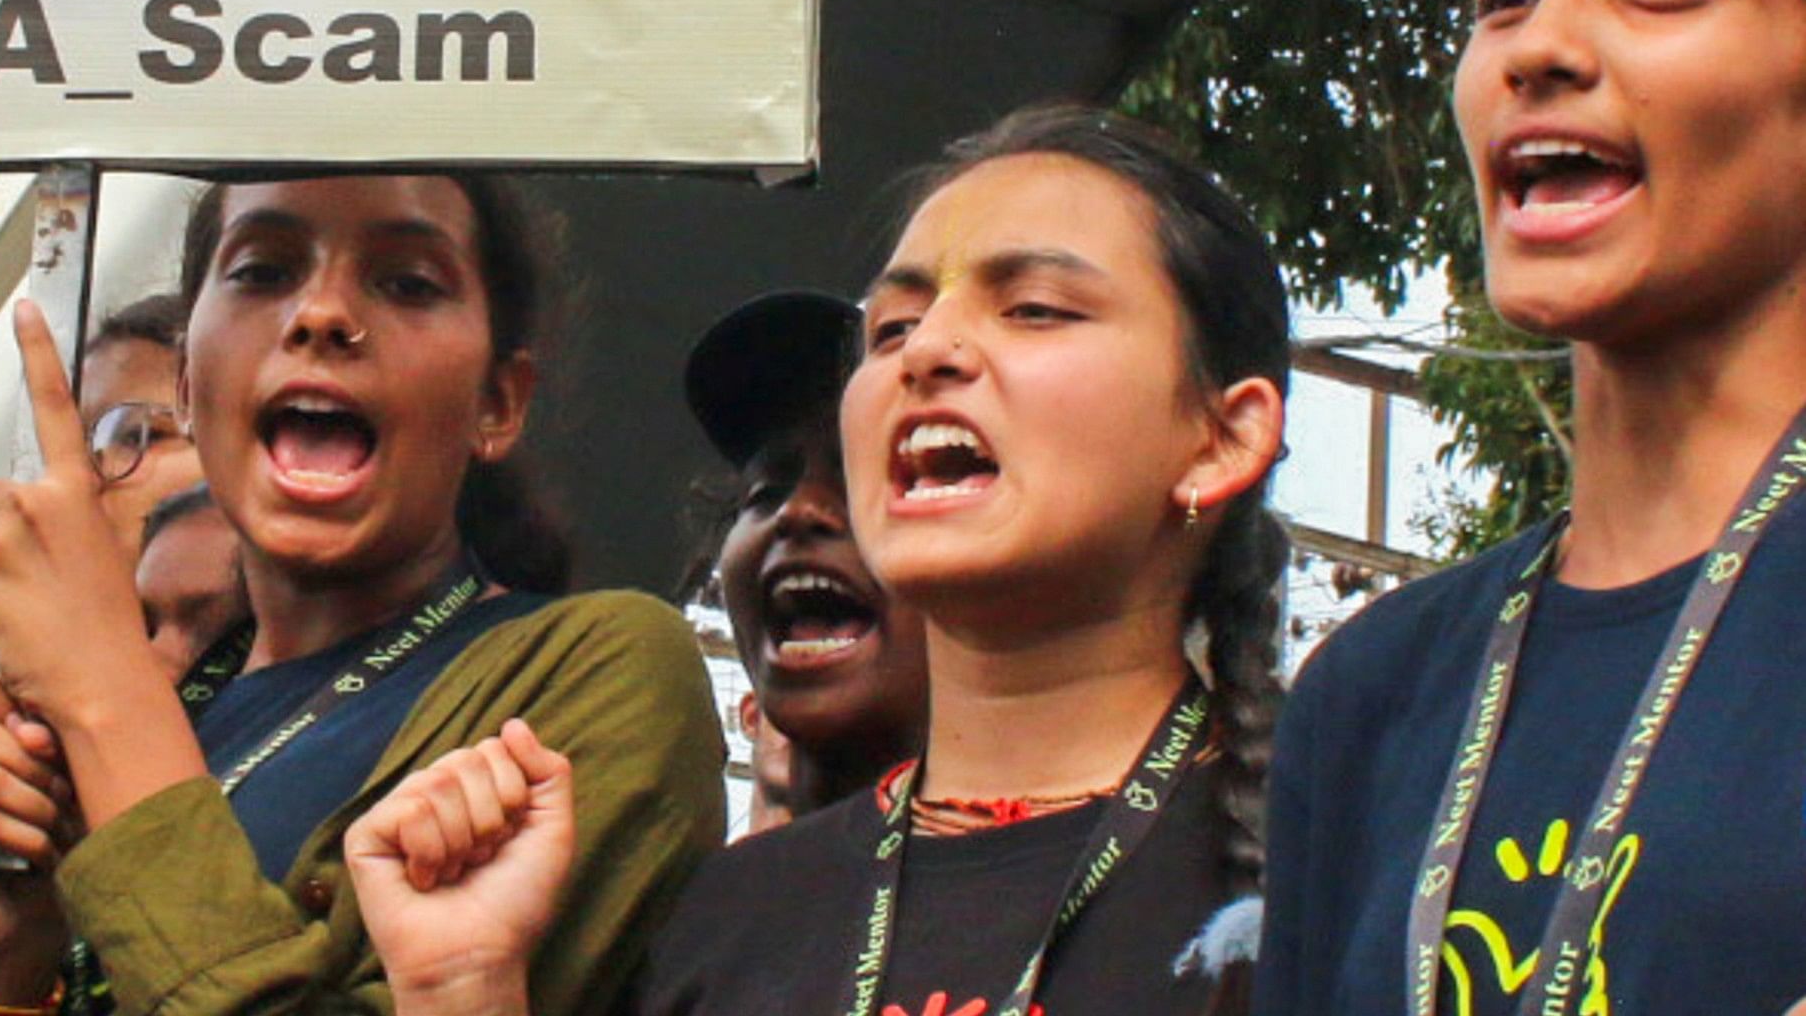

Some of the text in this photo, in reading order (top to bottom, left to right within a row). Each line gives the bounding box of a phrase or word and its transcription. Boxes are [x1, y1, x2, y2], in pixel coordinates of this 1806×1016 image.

[1730, 471, 1800, 533] Neet
[1435, 661, 1509, 850] Neet Mentor
[1595, 625, 1704, 833] Neet Mentor
[854, 886, 892, 976] Mentor
